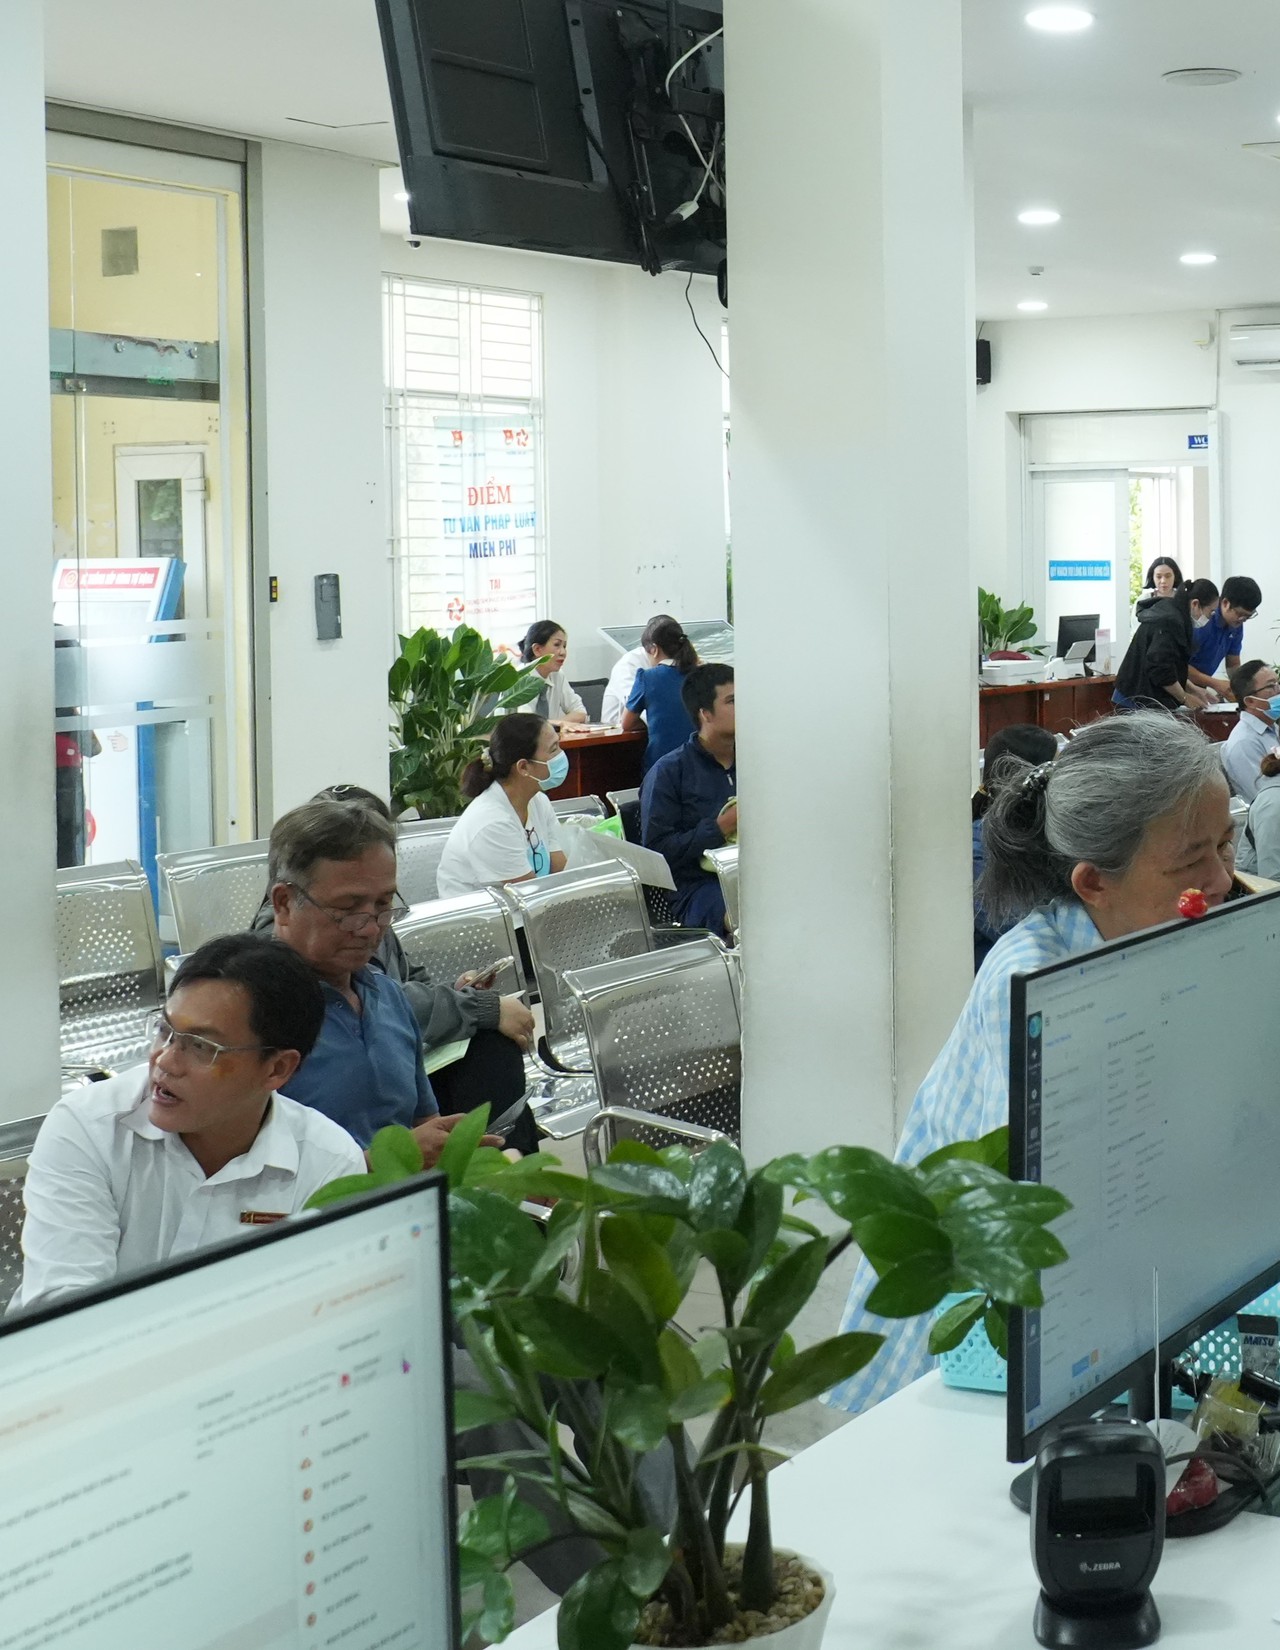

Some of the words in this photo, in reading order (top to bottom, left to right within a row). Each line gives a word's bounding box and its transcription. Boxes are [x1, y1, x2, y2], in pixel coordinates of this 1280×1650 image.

[468, 476, 512, 506] ĐIỂM
[1243, 1335, 1275, 1347] MATSU
[1092, 1561, 1121, 1571] ZEBRA
